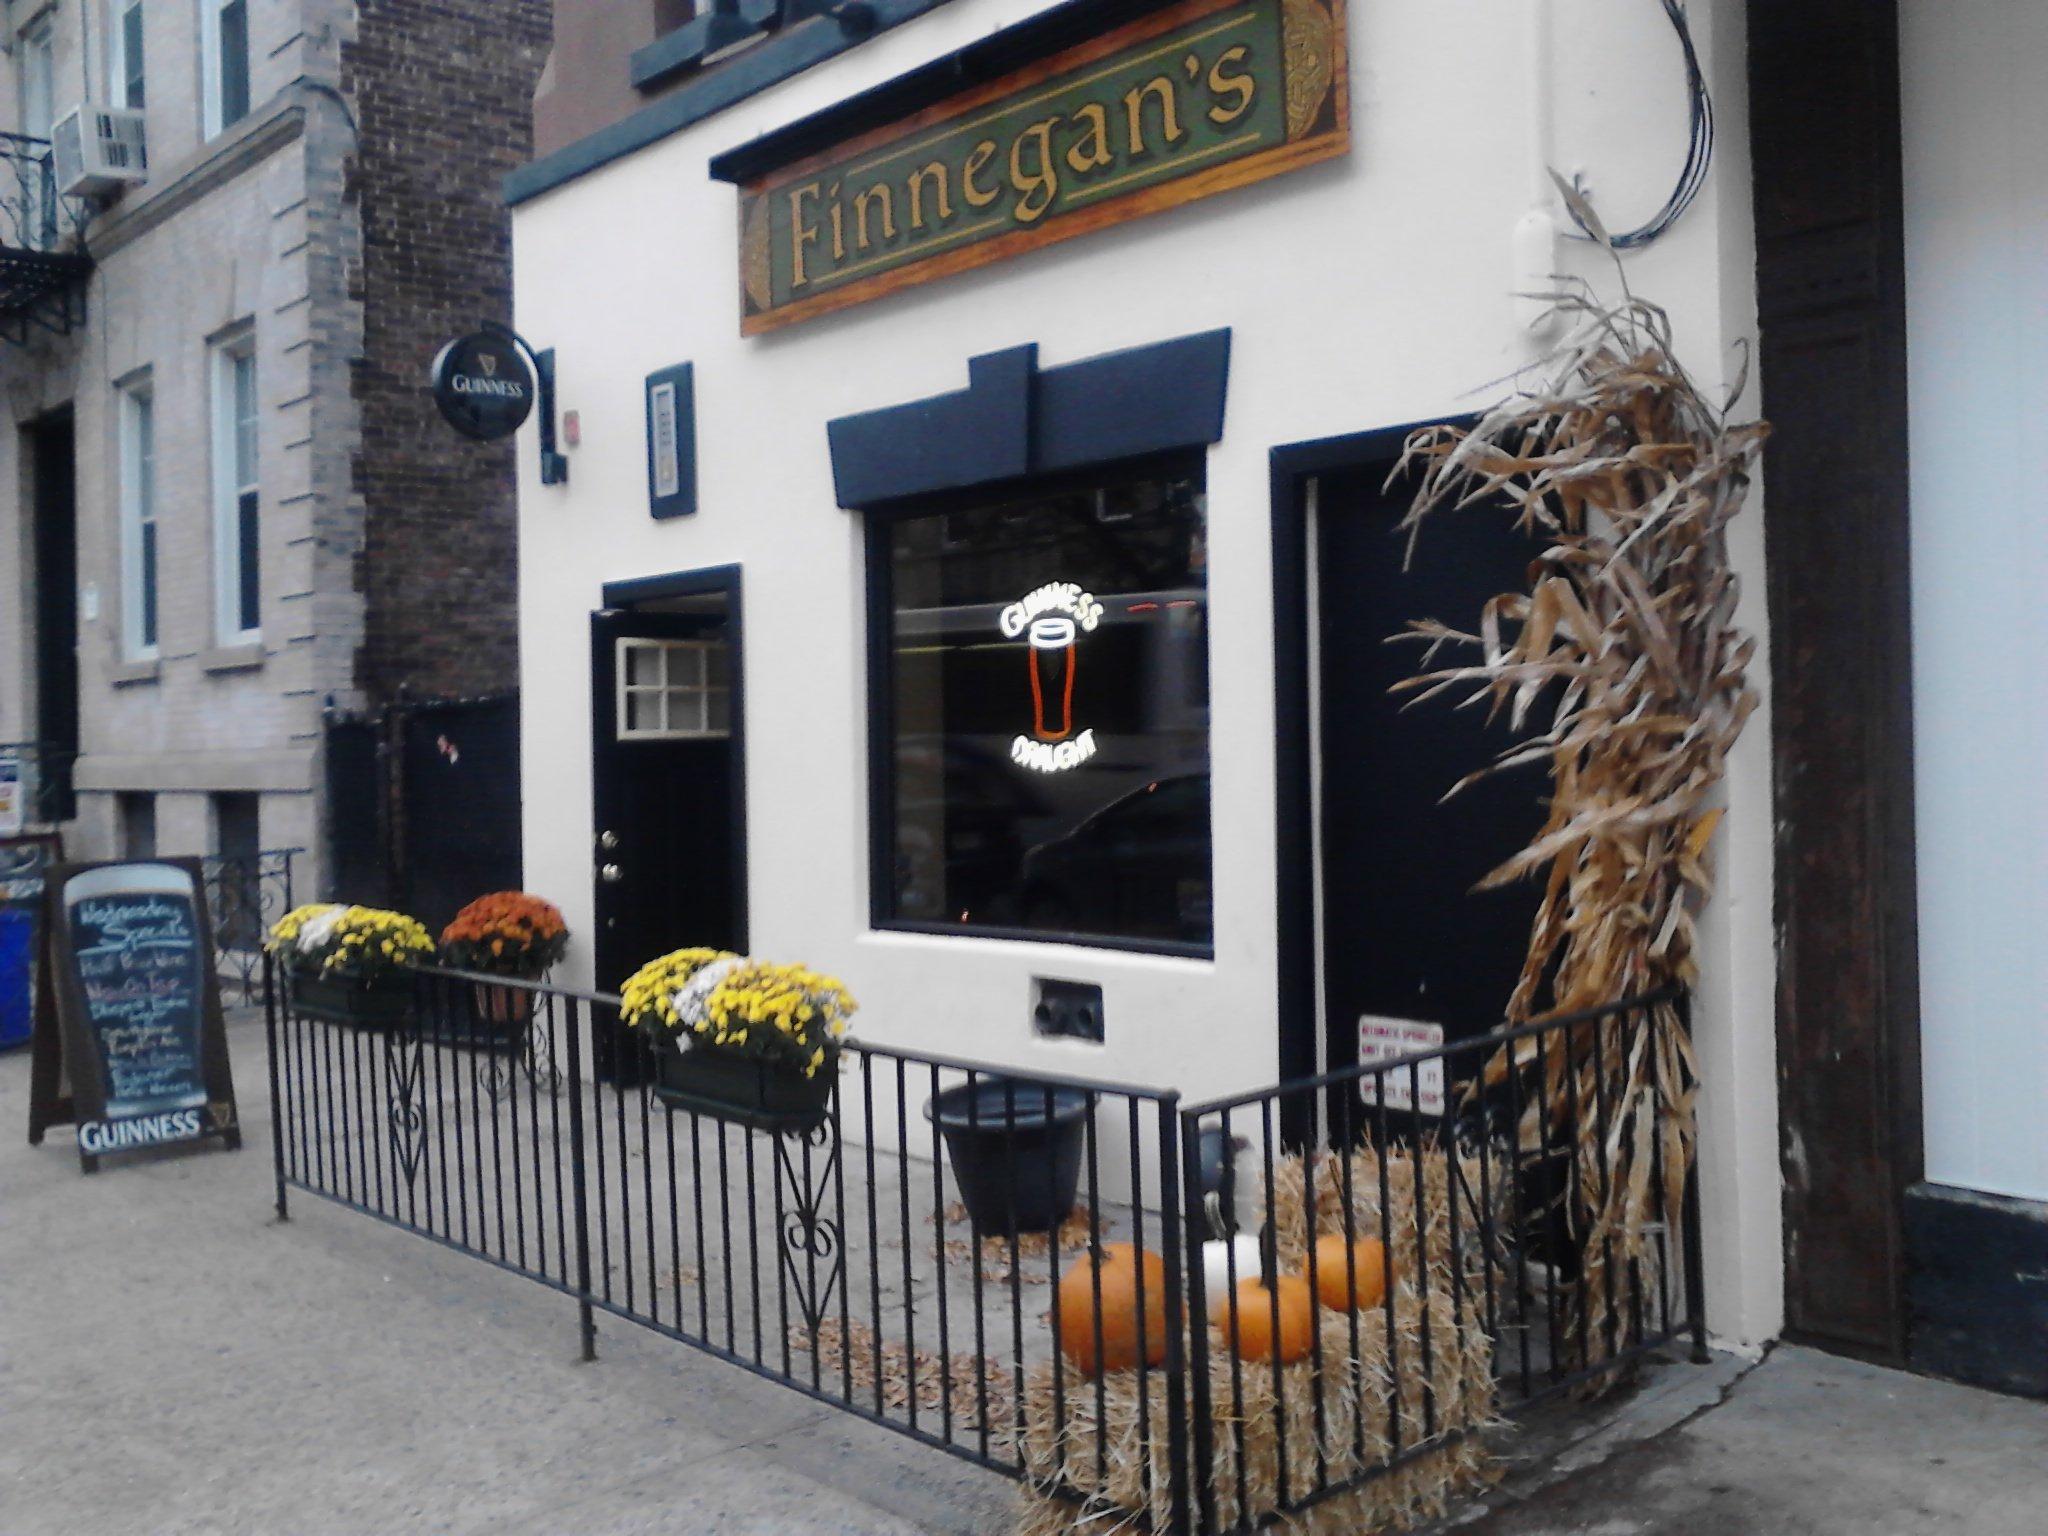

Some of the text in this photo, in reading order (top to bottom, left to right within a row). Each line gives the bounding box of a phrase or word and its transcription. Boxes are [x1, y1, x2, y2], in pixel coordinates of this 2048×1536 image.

[789, 43, 1257, 289] Finnegan's
[452, 374, 524, 397] GUINNESS
[1000, 581, 1104, 638] GUINNESS
[79, 1109, 201, 1151] GUINNESS
